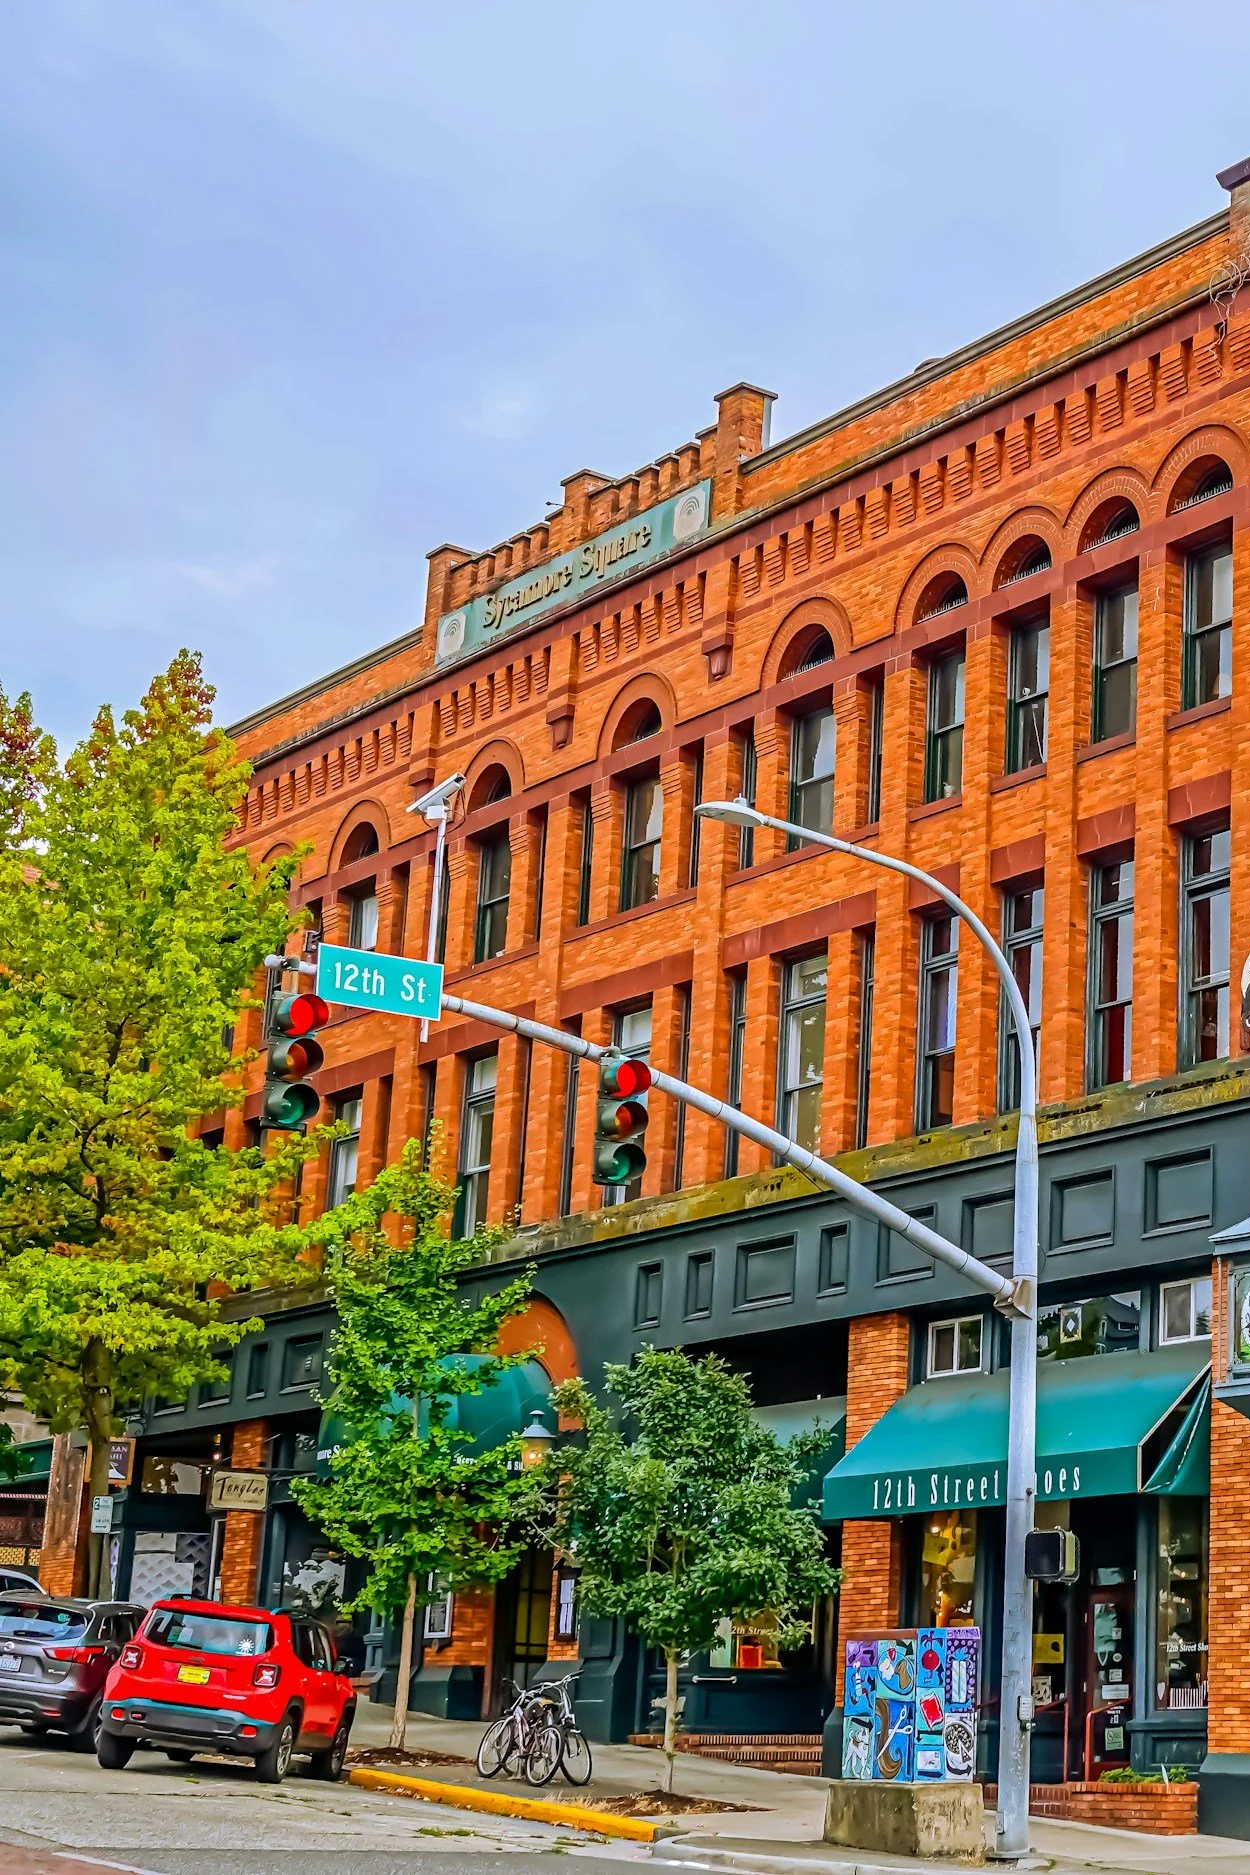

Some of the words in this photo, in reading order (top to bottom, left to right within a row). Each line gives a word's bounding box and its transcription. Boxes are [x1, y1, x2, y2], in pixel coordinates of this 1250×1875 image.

[482, 562, 575, 629] Sycamore
[579, 524, 651, 579] Square
[334, 961, 385, 996] 12th
[400, 974, 427, 1003] St
[1245, 1312, 1250, 1323] 9
[873, 1476, 916, 1510] 12th
[930, 1469, 999, 1505] Street
[1033, 1466, 1081, 1497] oes
[1180, 1643, 1197, 1652] Street
[1197, 1642, 1209, 1652] Sho
